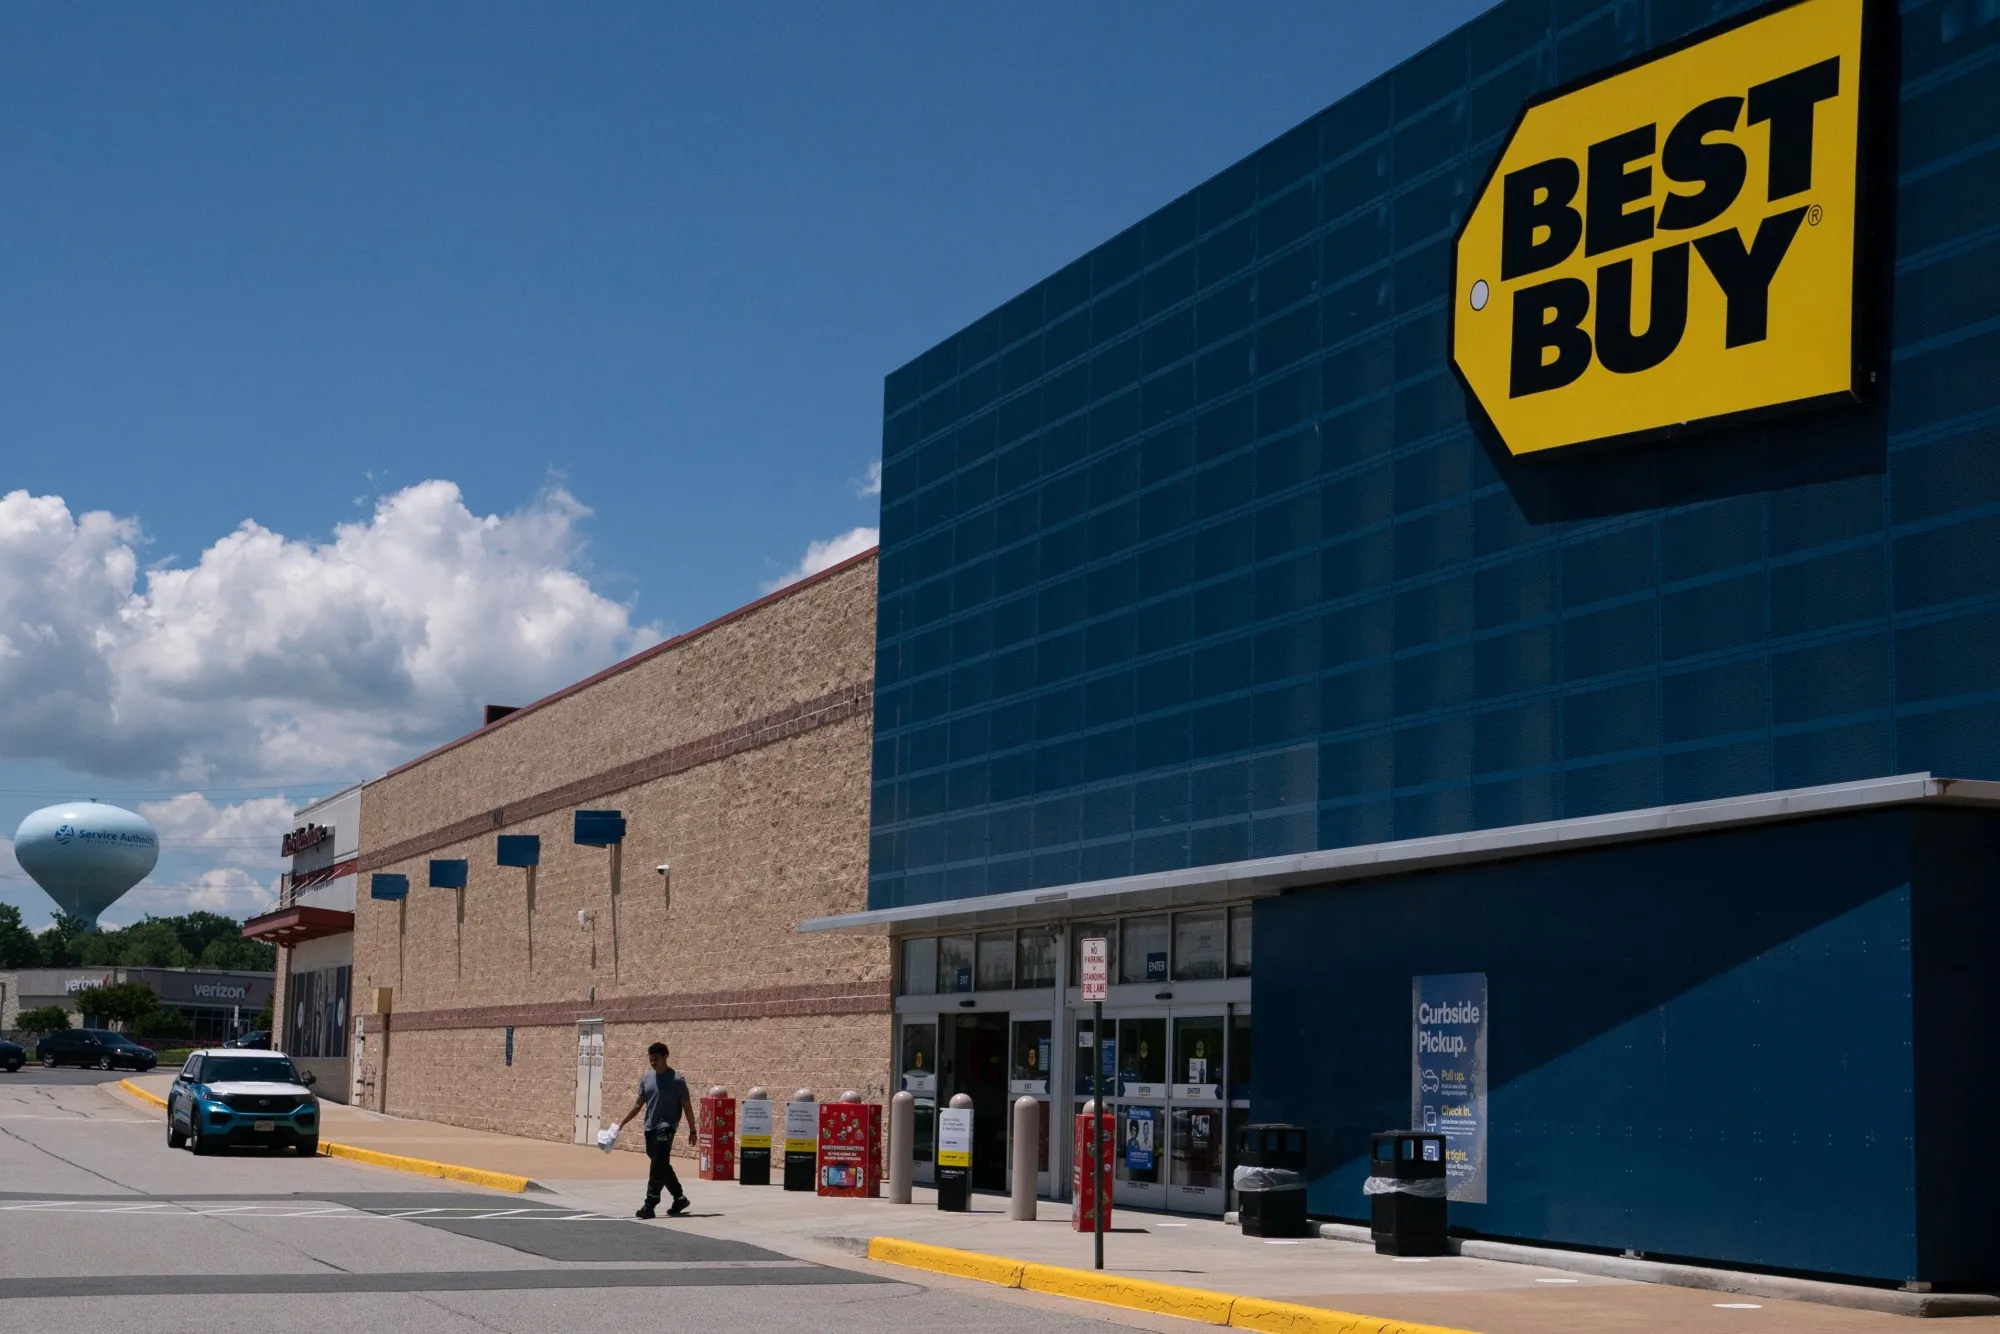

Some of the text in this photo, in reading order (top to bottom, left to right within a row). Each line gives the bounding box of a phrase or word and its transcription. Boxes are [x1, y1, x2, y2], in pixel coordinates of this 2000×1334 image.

[1501, 55, 1840, 282] BEST
[1509, 204, 1811, 399] BUY
[79, 829, 118, 841] Service
[120, 832, 155, 847] Authority
[1091, 946, 1097, 954] NO
[1085, 955, 1104, 963] PARKING
[1148, 960, 1165, 972] ENTER
[960, 975, 968, 985] EXIT
[1083, 973, 1105, 981] STANDING
[194, 983, 245, 999] verizon
[1083, 983, 1105, 993] FIRE LANE
[1419, 1001, 1480, 1024] Curbside
[1419, 1031, 1467, 1057] Pickup.
[1441, 1069, 1465, 1083] Pull up.
[1187, 1087, 1200, 1095] ENTER
[1441, 1105, 1472, 1116] Check in.
[1451, 1149, 1468, 1163] tight.
